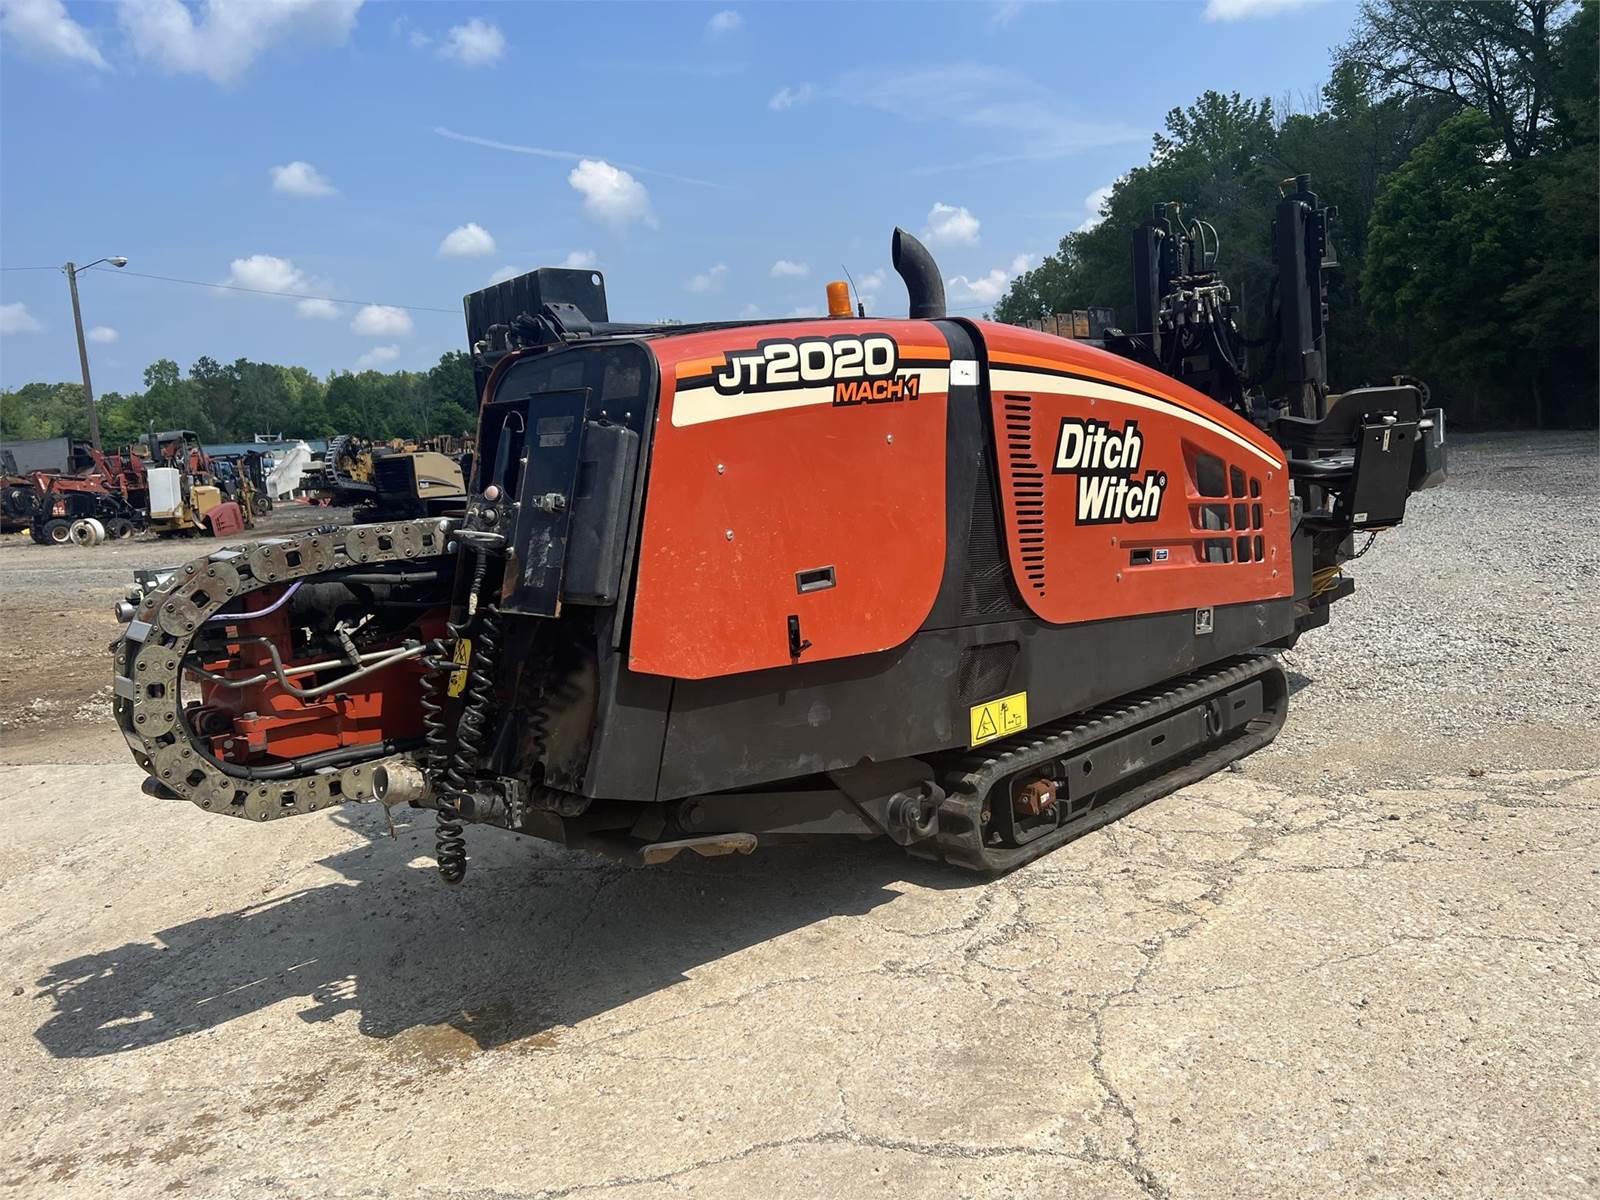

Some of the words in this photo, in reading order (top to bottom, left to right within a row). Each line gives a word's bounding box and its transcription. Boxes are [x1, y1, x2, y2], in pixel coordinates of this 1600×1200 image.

[718, 337, 895, 387] JT2020
[835, 377, 902, 402] MACH
[906, 378, 920, 396] 1
[1056, 424, 1142, 468] Ditch
